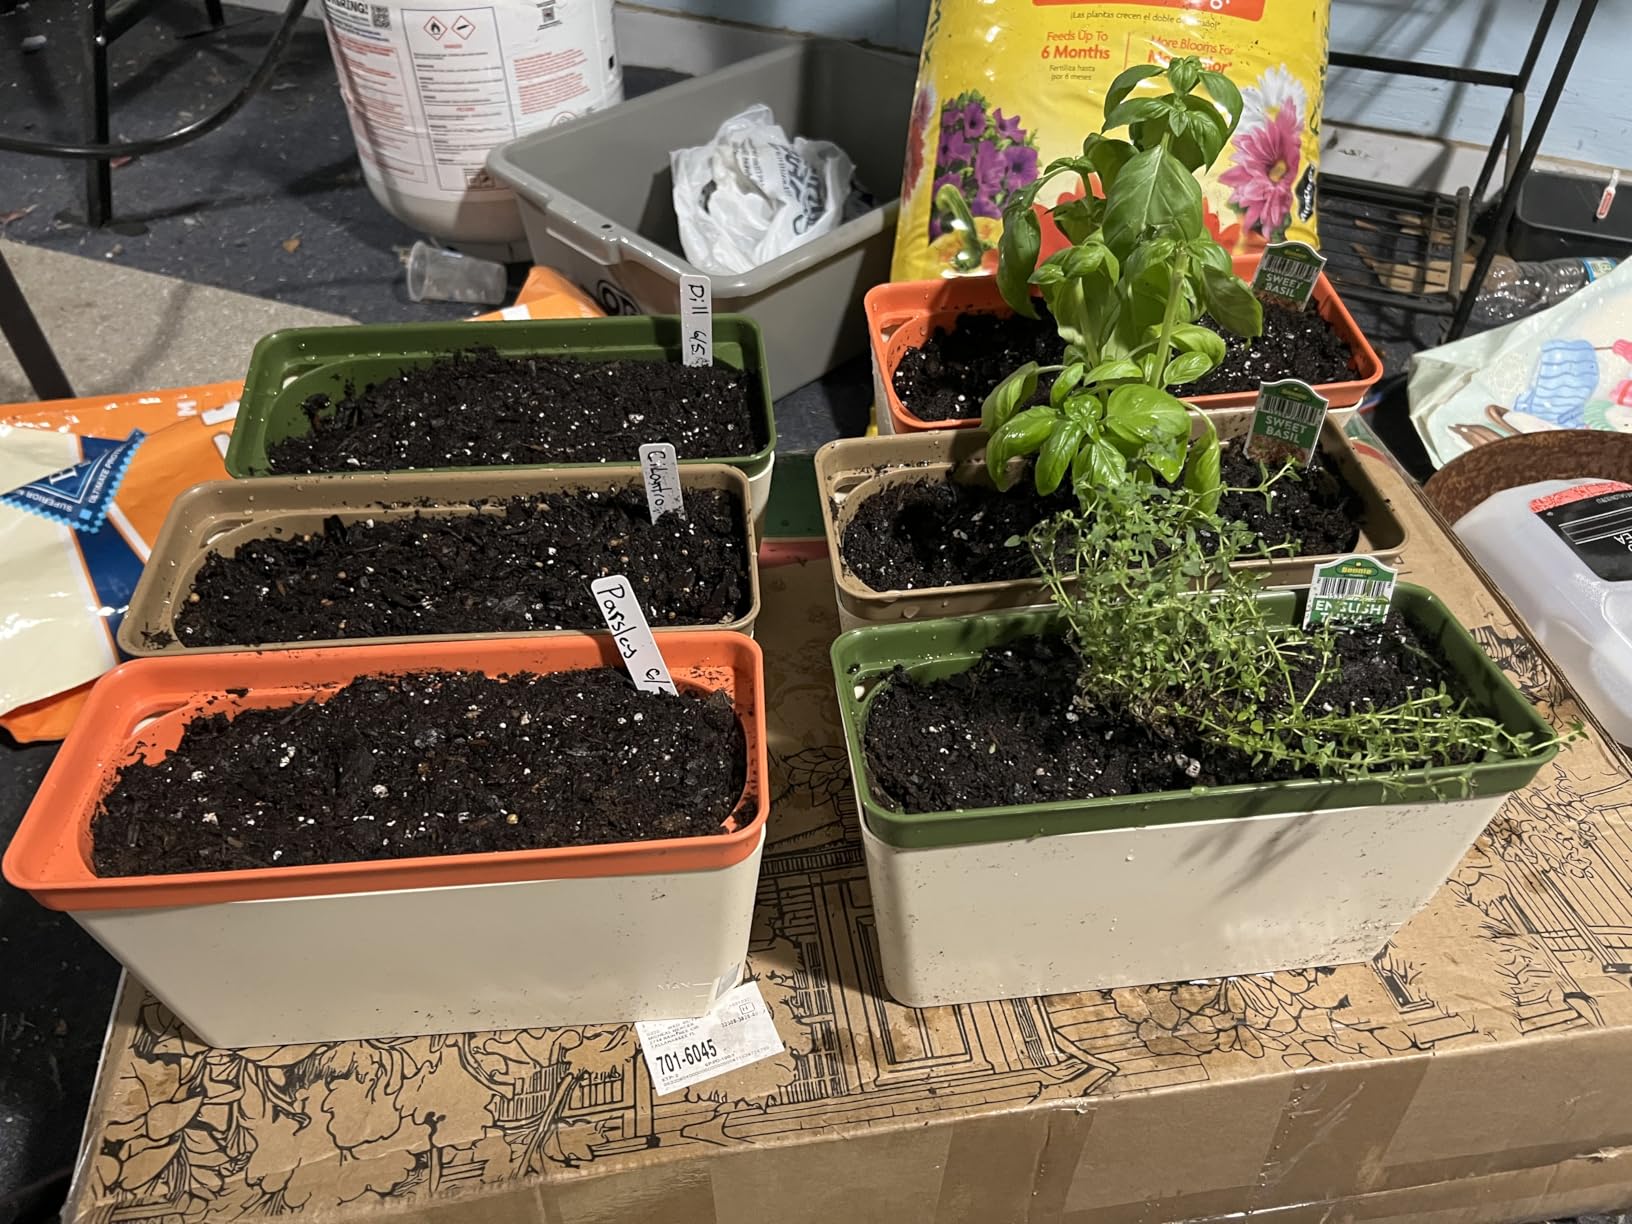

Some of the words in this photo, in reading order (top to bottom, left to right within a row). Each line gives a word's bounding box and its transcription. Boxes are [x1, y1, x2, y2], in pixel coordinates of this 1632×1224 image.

[1086, 11, 1115, 19] plantas
[1152, 13, 1175, 22] doble
[1046, 30, 1076, 41] Feeds
[1077, 30, 1094, 43] Up
[1096, 31, 1109, 41] To
[1041, 45, 1051, 59] 6
[1053, 44, 1110, 59] Months
[1180, 38, 1217, 53] Blooms
[1219, 44, 1235, 55] For
[1265, 273, 1304, 289] SWEET
[1265, 282, 1295, 297] BASIL
[688, 284, 709, 315] Dill
[1265, 415, 1307, 434] SWEET
[1265, 426, 1300, 443] BASIL
[25, 491, 73, 512] SUPERIOR
[596, 583, 638, 659] Parsley
[656, 1039, 717, 1075] 701-6045
